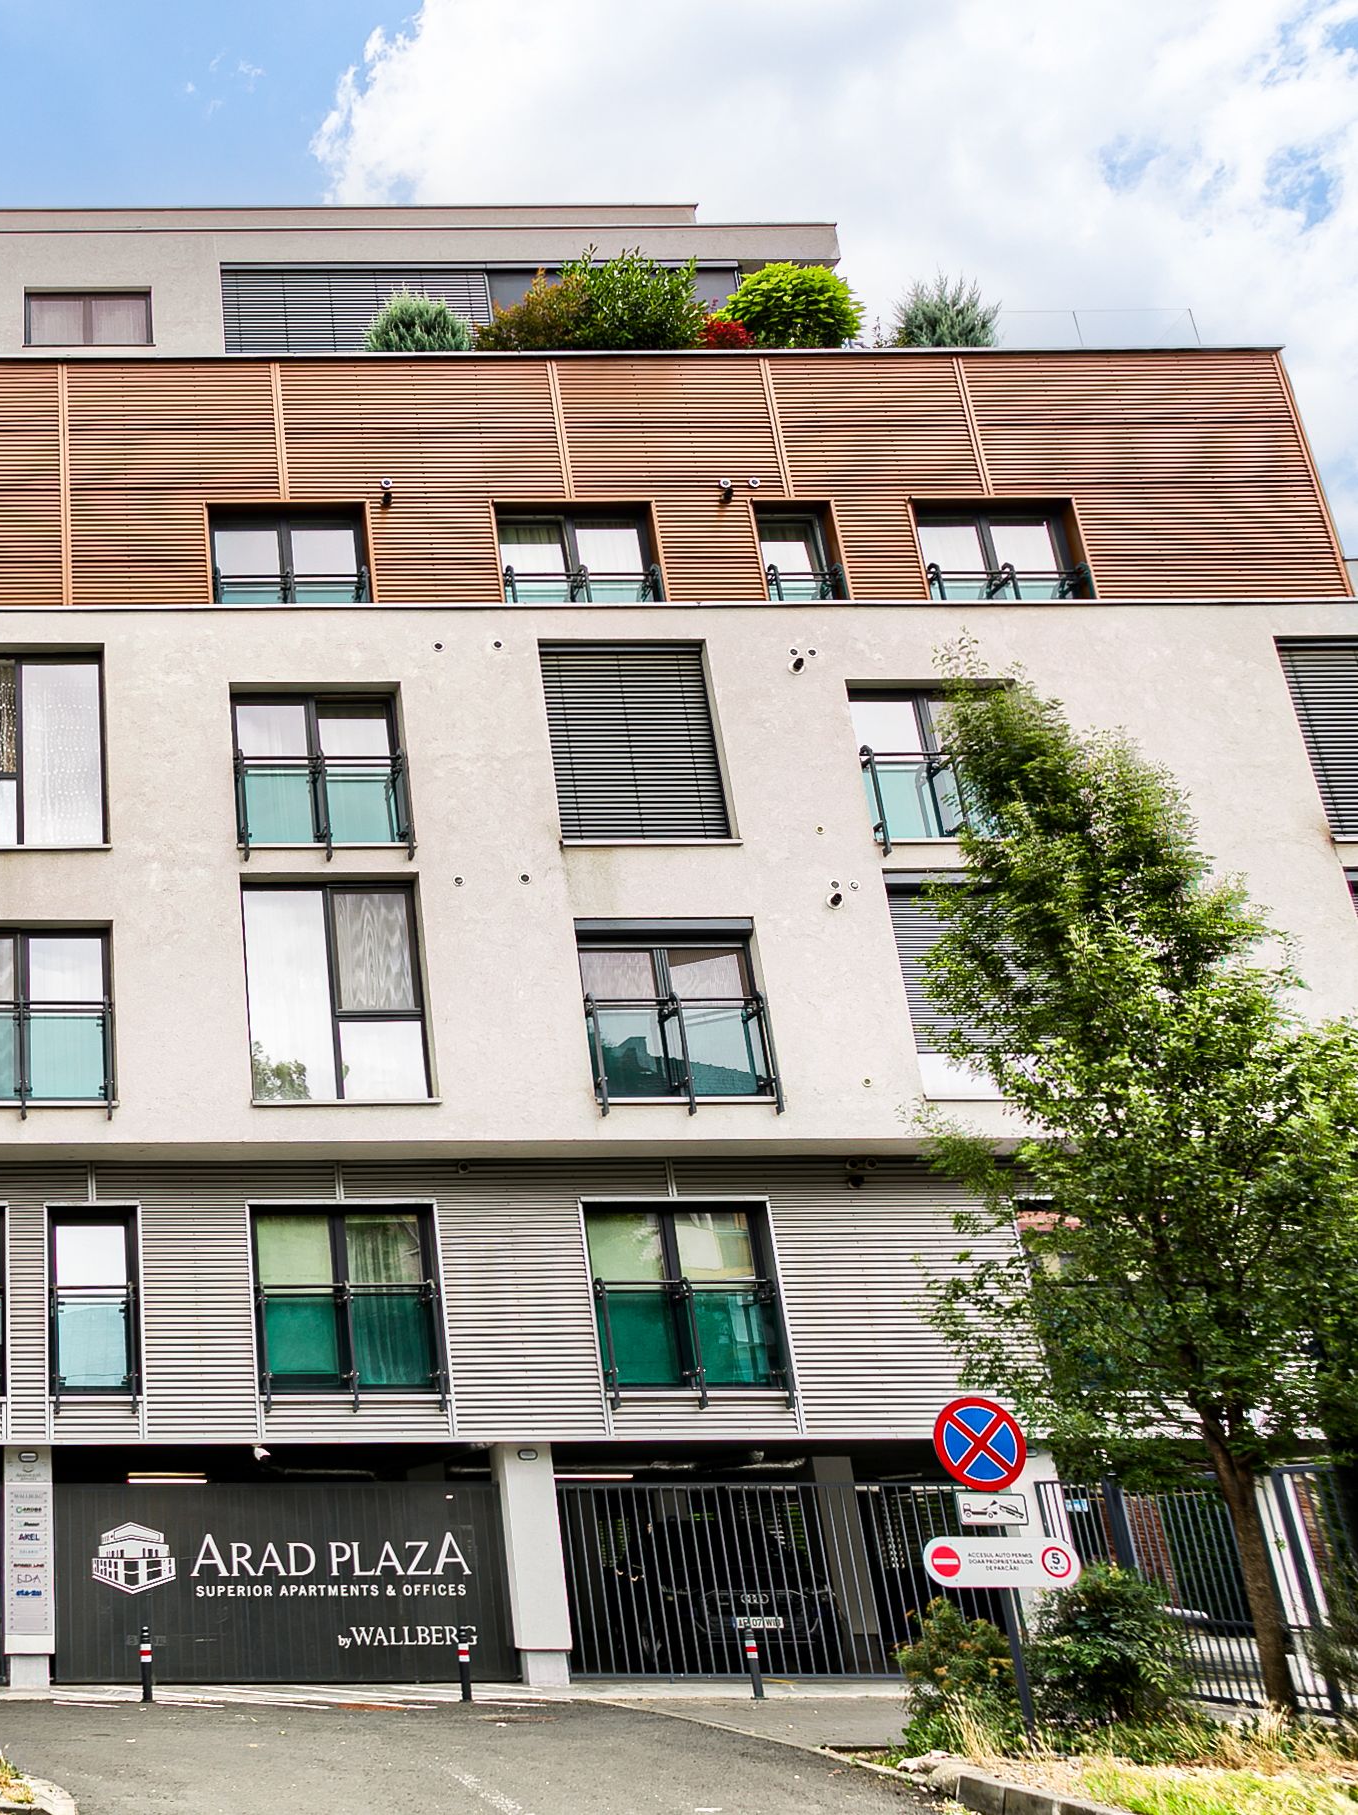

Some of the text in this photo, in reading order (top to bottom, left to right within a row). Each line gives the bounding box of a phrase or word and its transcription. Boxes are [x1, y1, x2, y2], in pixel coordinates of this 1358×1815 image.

[190, 1531, 472, 1577] ARAD PLAZA
[1051, 1552, 1061, 1565] 5
[196, 1583, 467, 1598] SUPERIOR APARTMENTS & OFFICES
